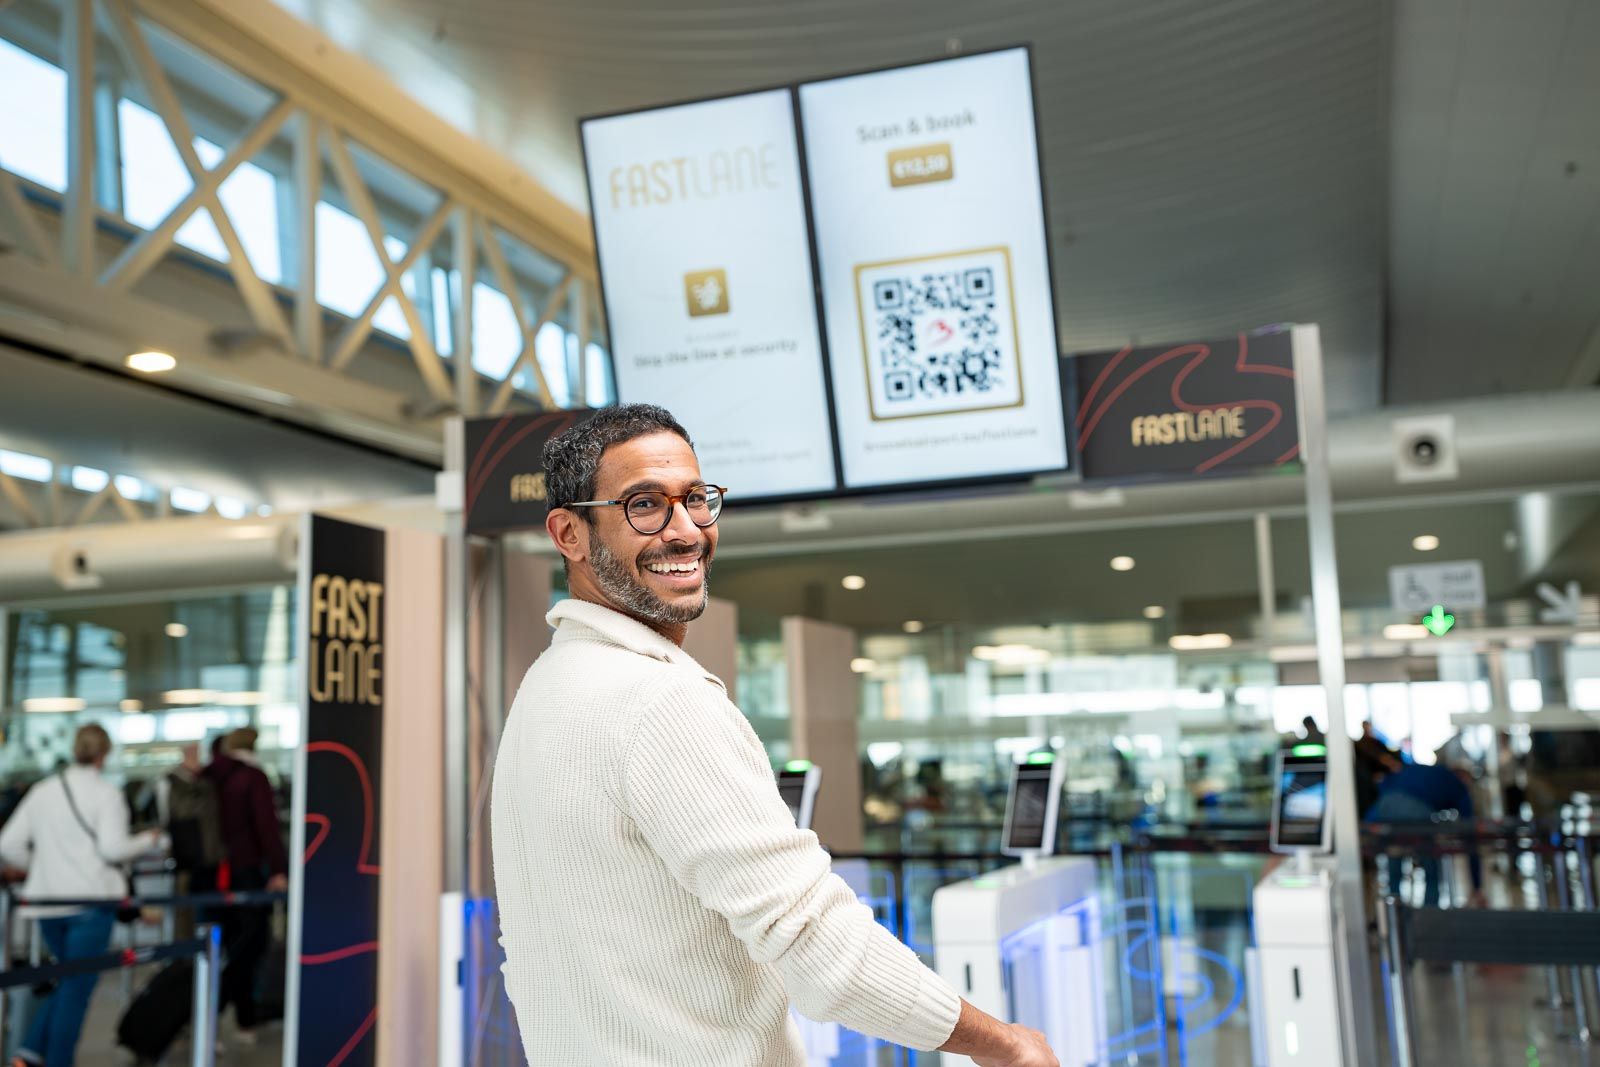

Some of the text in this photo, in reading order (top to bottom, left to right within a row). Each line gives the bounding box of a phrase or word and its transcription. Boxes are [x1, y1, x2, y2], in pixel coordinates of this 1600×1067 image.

[857, 107, 977, 144] Scan & book
[609, 143, 780, 210] FASTLANE
[665, 351, 689, 364] the
[740, 338, 799, 357] security
[1131, 406, 1246, 447] FASTLANE
[311, 573, 383, 643] FAST
[310, 638, 382, 705] LANE
